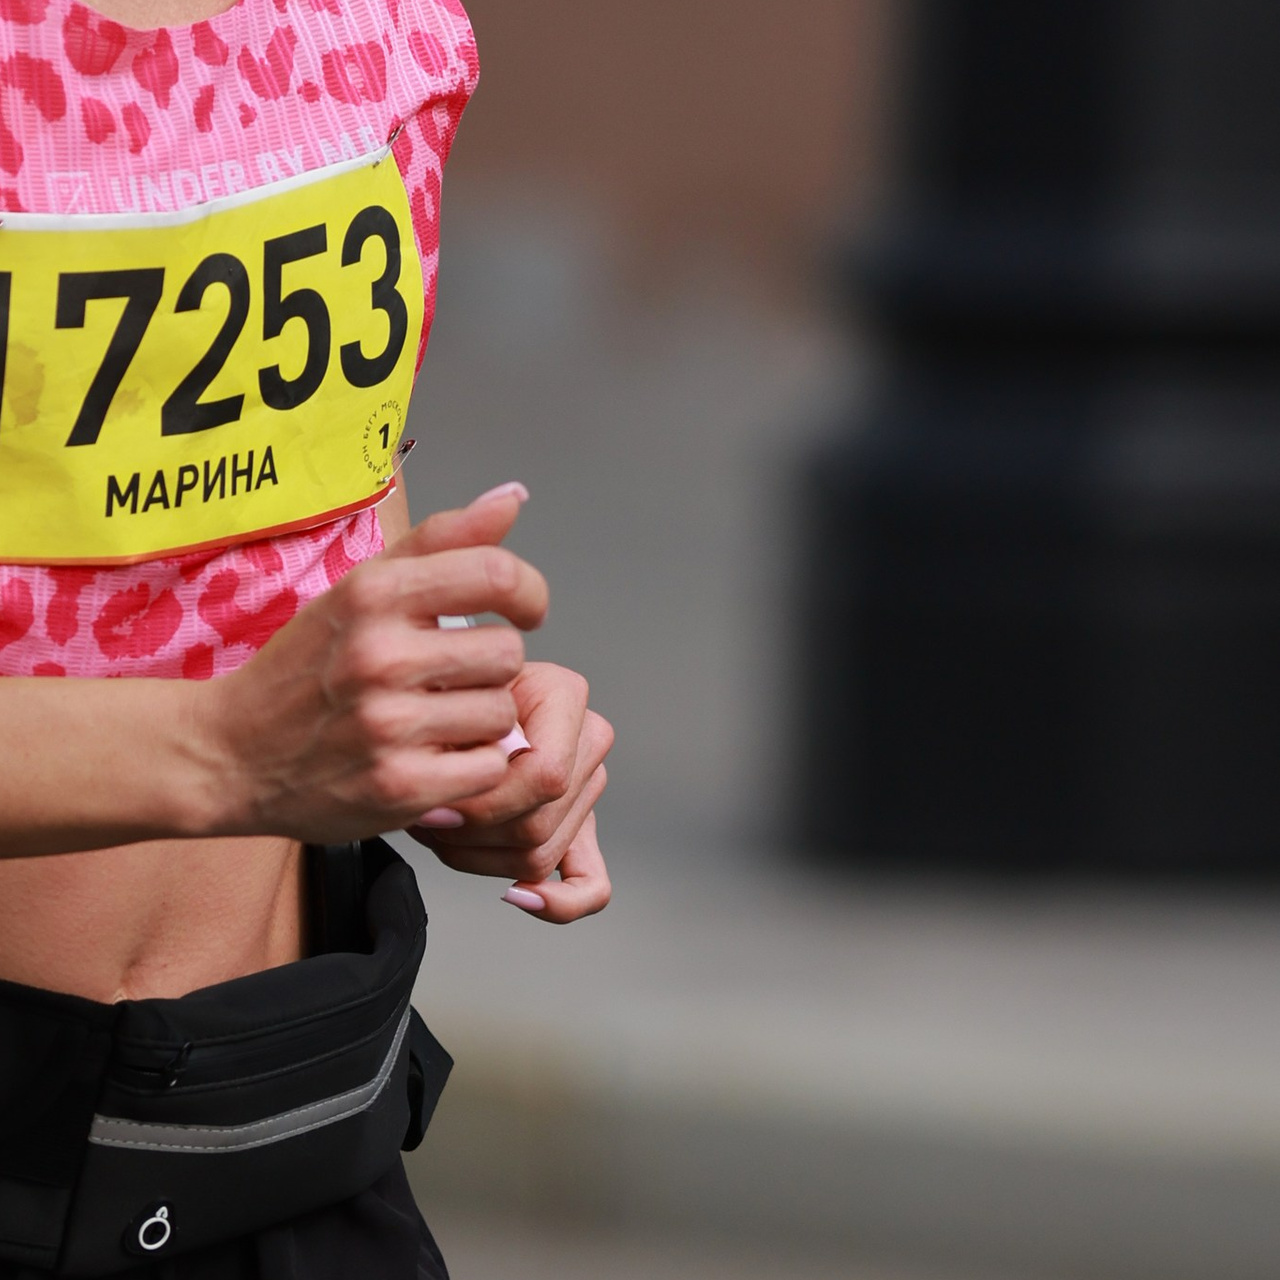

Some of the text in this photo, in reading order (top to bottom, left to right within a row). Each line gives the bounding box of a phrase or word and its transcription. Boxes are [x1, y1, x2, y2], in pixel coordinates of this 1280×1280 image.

[110, 159, 249, 212] UNDER
[378, 422, 390, 450] 1
[362, 445, 392, 474] АРАФОН
[105, 445, 279, 518] МАРИНА
